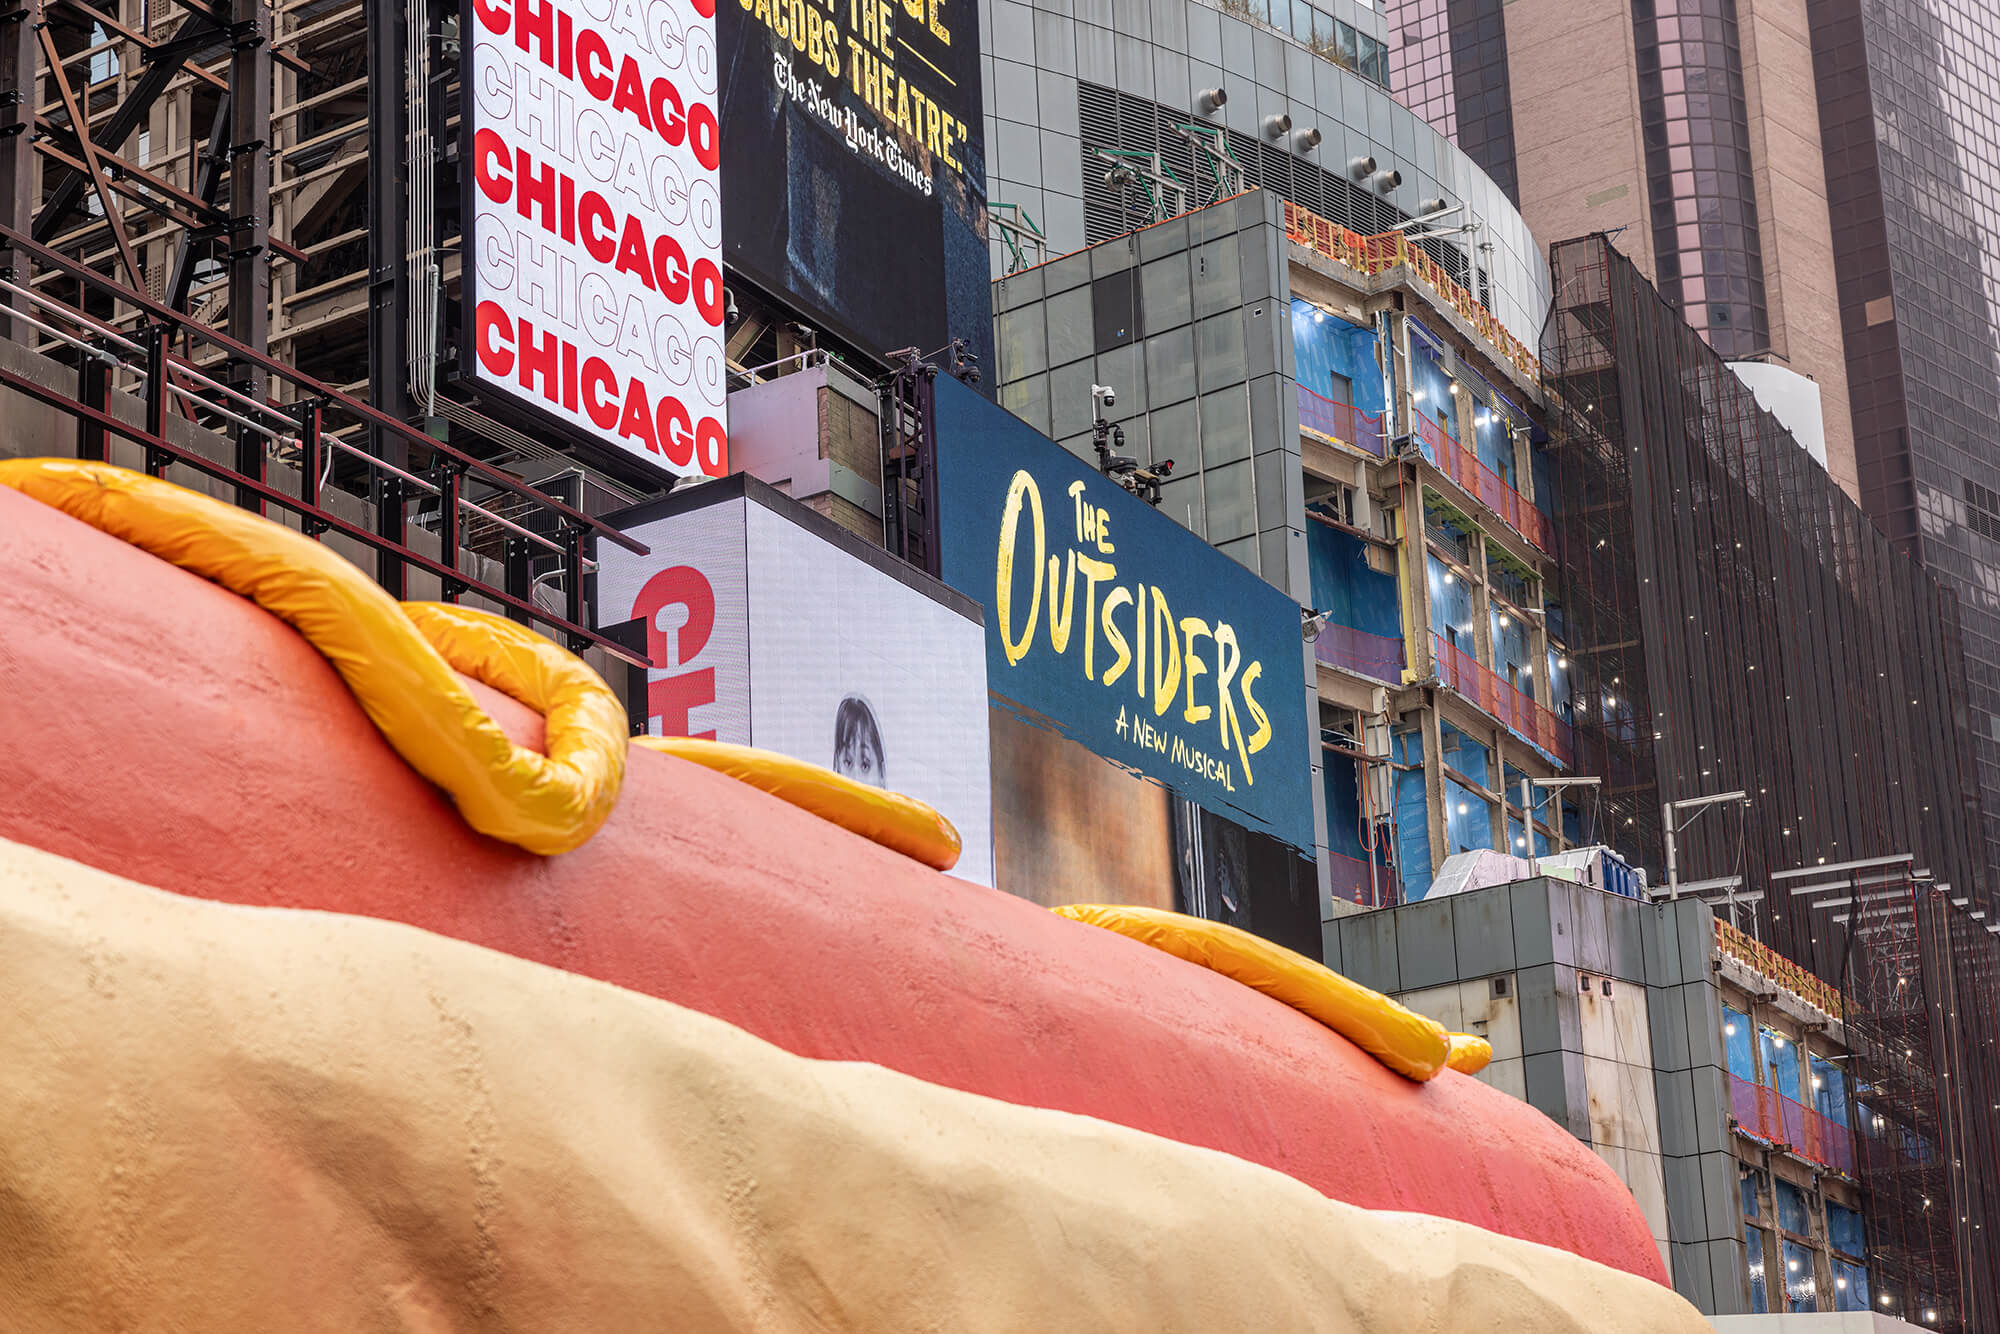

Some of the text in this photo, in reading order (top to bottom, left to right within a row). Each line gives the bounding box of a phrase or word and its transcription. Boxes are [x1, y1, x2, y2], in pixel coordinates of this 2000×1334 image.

[739, 0, 841, 78] ACOBS
[774, 52, 933, 196] The New York Times
[474, 43, 722, 249] CHICAGO
[474, 128, 724, 327] CHICAGO
[475, 213, 726, 407] CHICAGO
[475, 300, 729, 478] CHICAGO
[1068, 480, 1115, 554] THE
[996, 470, 1273, 786] OUTSIDERS
[1115, 704, 1236, 793] A NEW MUSICAL
